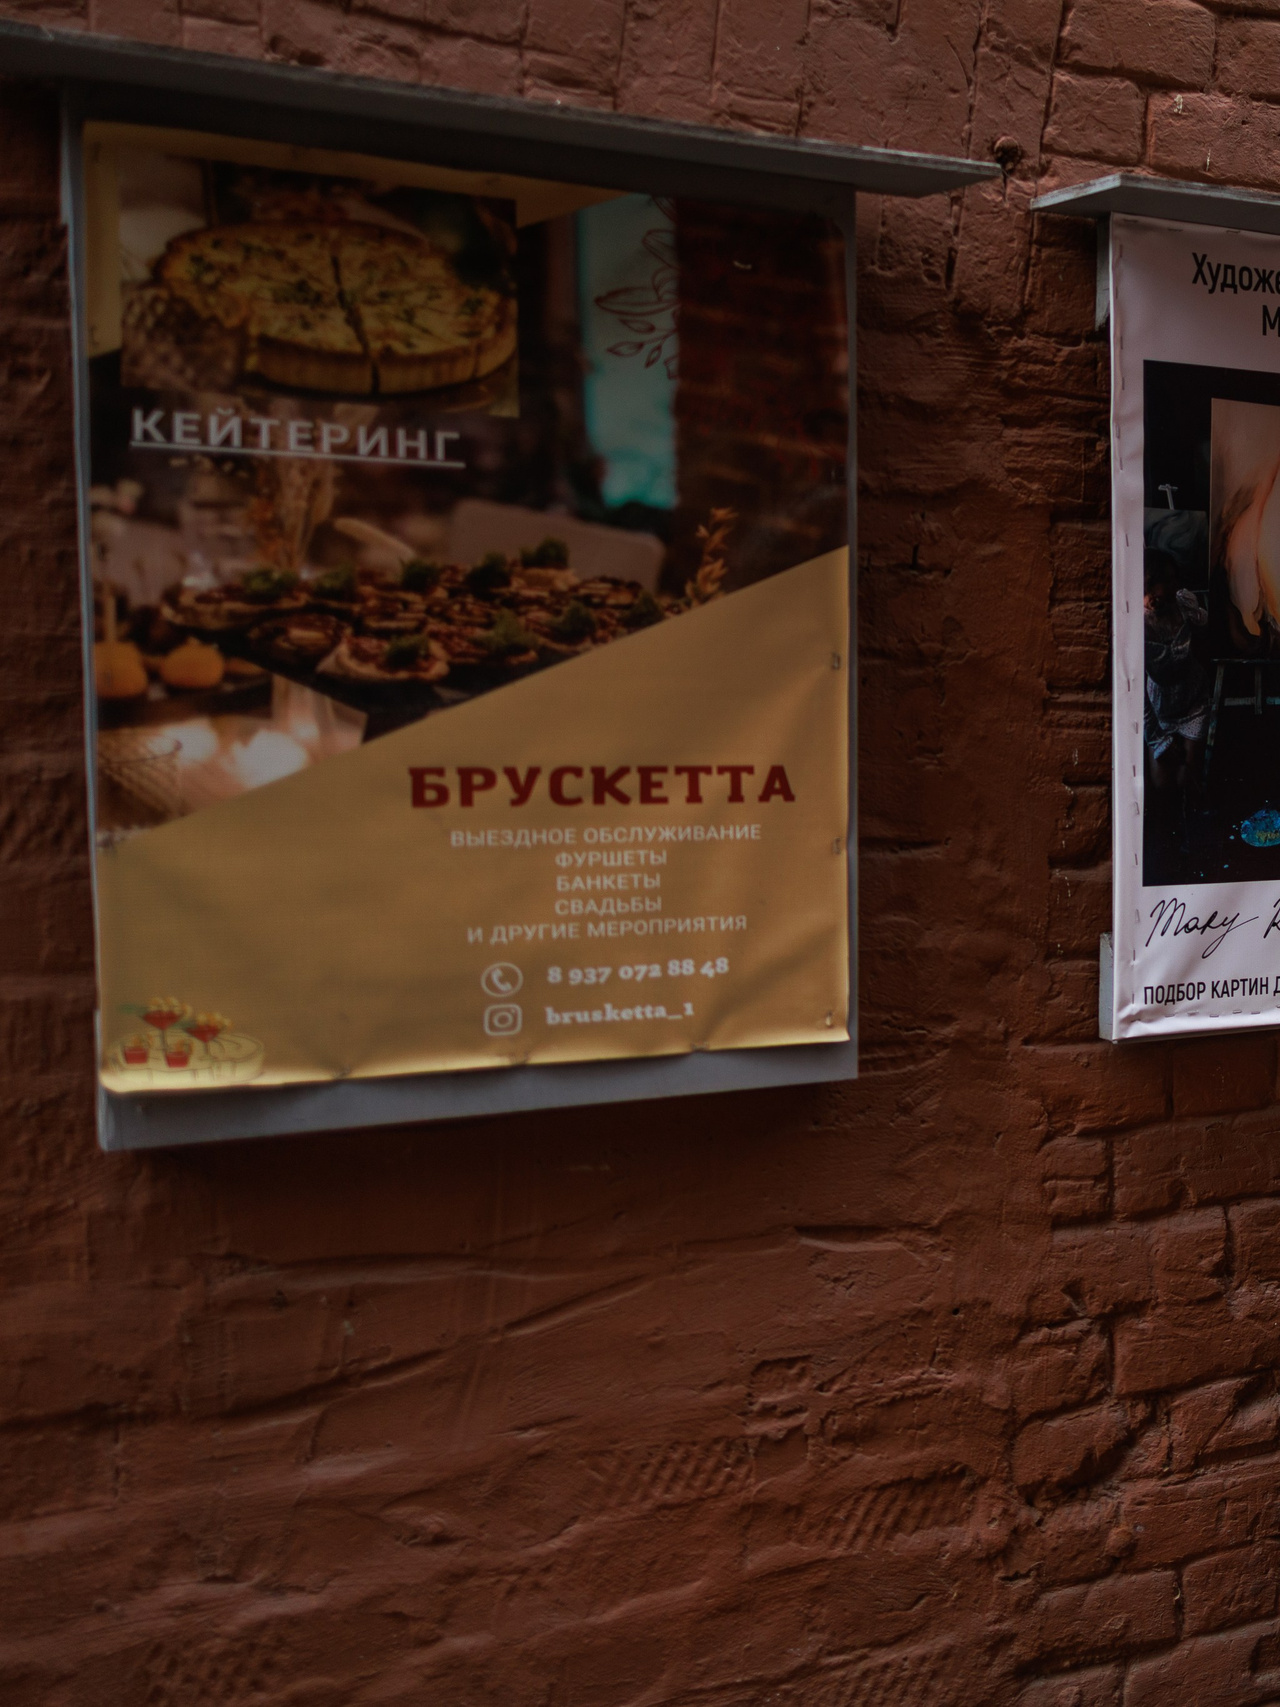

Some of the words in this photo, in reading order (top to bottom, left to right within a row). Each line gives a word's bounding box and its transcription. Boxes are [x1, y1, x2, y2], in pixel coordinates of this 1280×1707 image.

[131, 406, 461, 462] КЕЙТЕРИНГ
[408, 765, 796, 808] БРУСКЕТТА
[449, 828, 577, 850] ВЫЕЗДНОЕ
[582, 823, 762, 845] ОБСЛУЖИВАНИЕ
[554, 849, 668, 869] ФУРШЕТЫ
[556, 873, 662, 892] БАНКЕТЫ
[554, 896, 663, 917] СВАДЬБЫ
[466, 926, 483, 945] И
[489, 922, 581, 946] ДРУГИЕ
[586, 915, 748, 939] МЕРОПРИЯТИЯ
[547, 966, 562, 984] 8
[568, 967, 613, 986] 937
[618, 964, 663, 983] 072
[667, 958, 696, 977] 88
[699, 956, 730, 979] 48
[1143, 981, 1206, 1006] ПОДБОР
[1210, 976, 1269, 999] КАРТИН
[544, 1001, 695, 1026] brusketta_1
